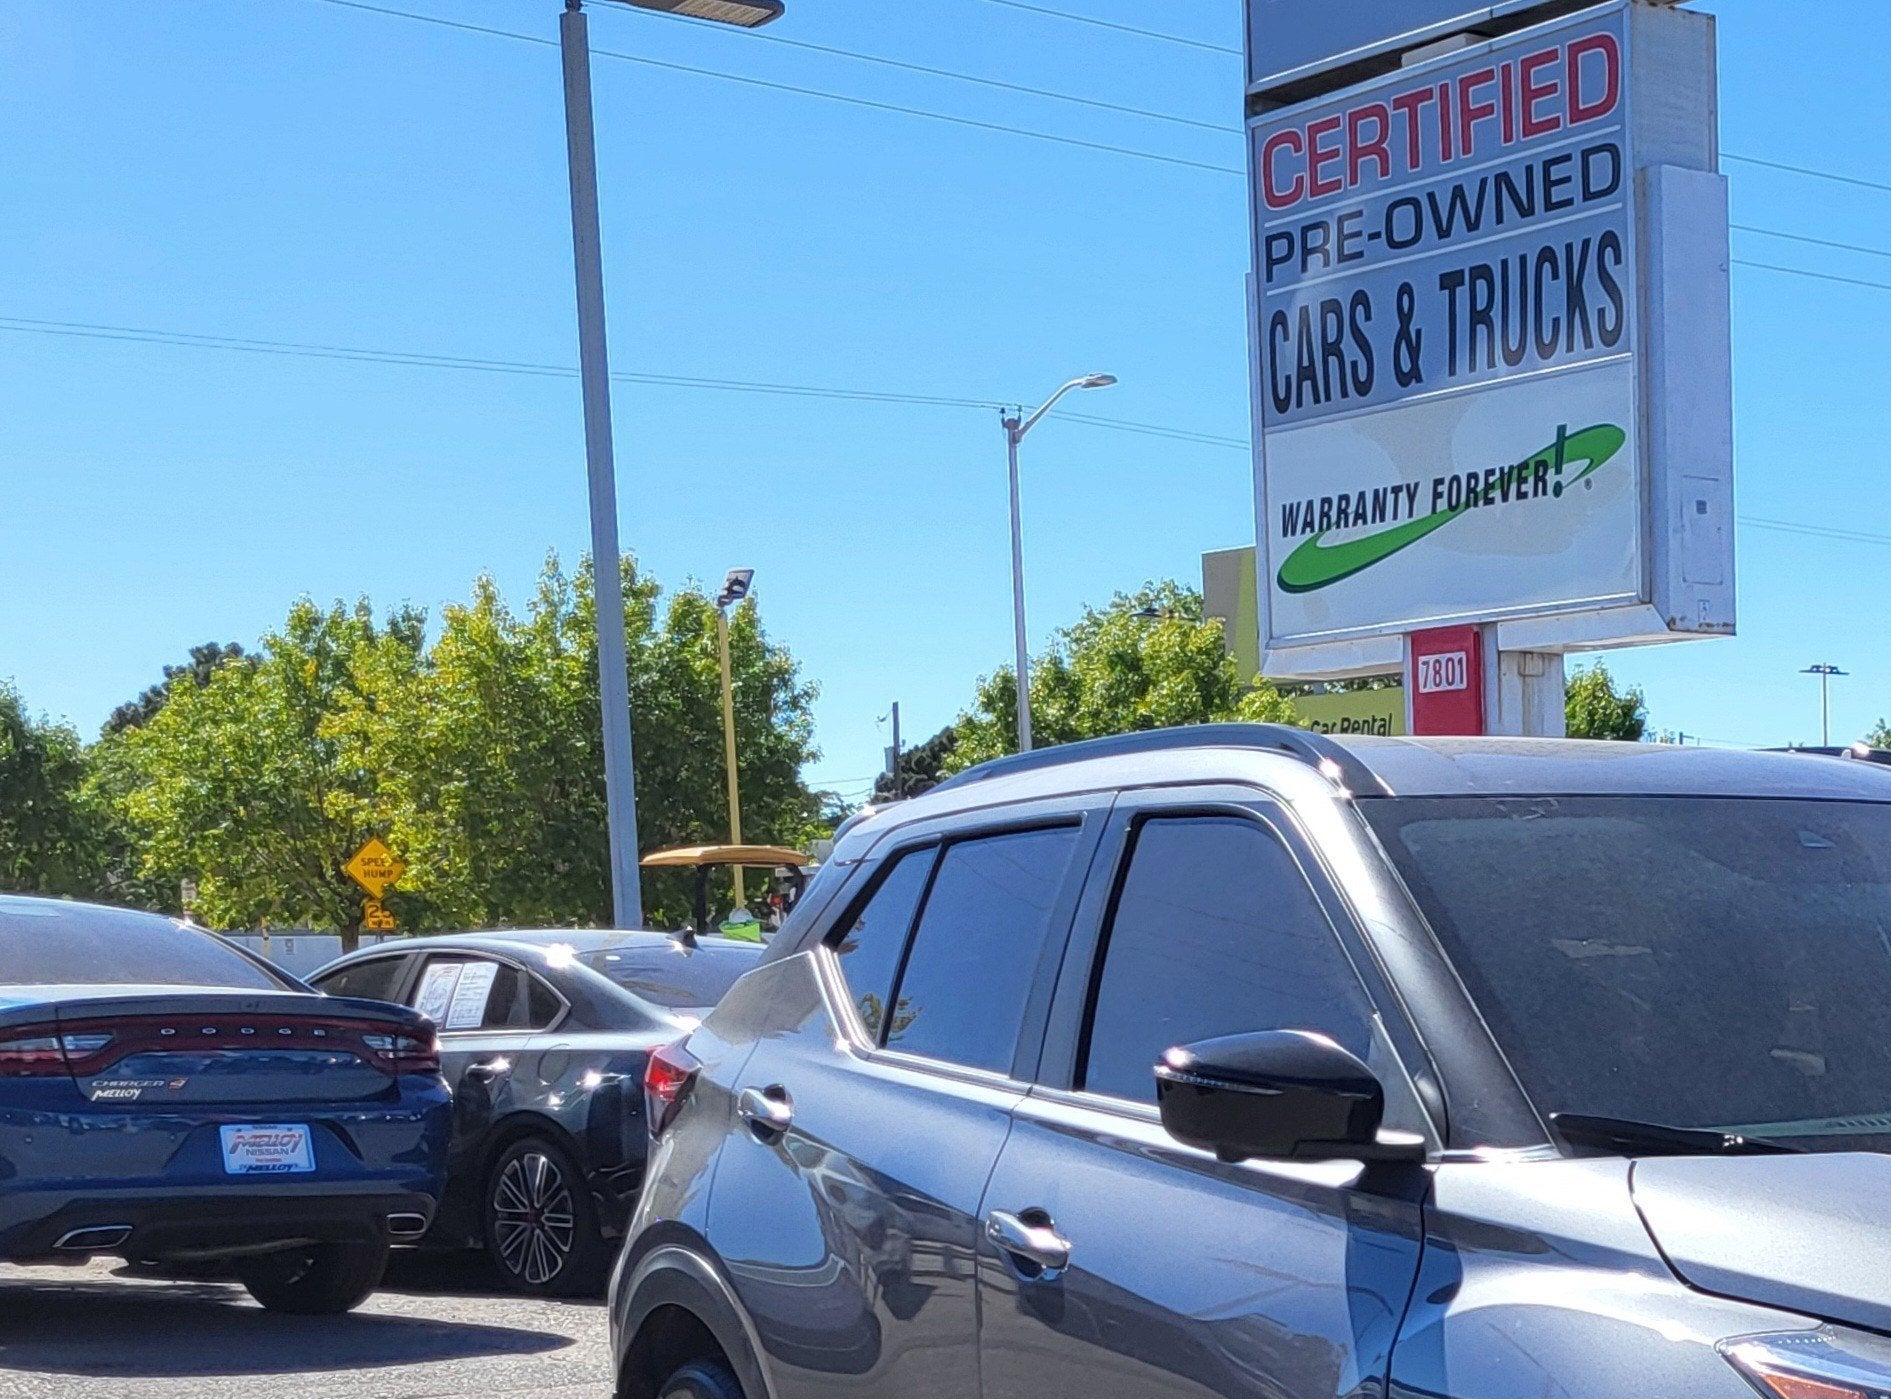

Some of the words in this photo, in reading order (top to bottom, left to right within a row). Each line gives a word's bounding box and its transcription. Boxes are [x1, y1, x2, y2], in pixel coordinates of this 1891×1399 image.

[1261, 31, 1622, 211] CERTIFIED
[1265, 142, 1622, 283] PRE-OWNED
[1269, 288, 1373, 415] CARS
[1394, 281, 1424, 389] &
[1439, 229, 1623, 378] TRUCKS
[1281, 480, 1421, 538] WARRANTY
[1431, 424, 1567, 514] FOREVER!
[1421, 656, 1465, 689] 7801
[1311, 719, 1337, 735] Car
[1340, 713, 1393, 736] Rental
[361, 858, 391, 867] SPEE
[363, 869, 393, 878] HUMP
[160, 1027, 325, 1037] DODGE
[91, 1088, 142, 1102] MELLOY
[229, 1133, 304, 1154] MELLOY
[245, 1148, 290, 1156] NISSAN
